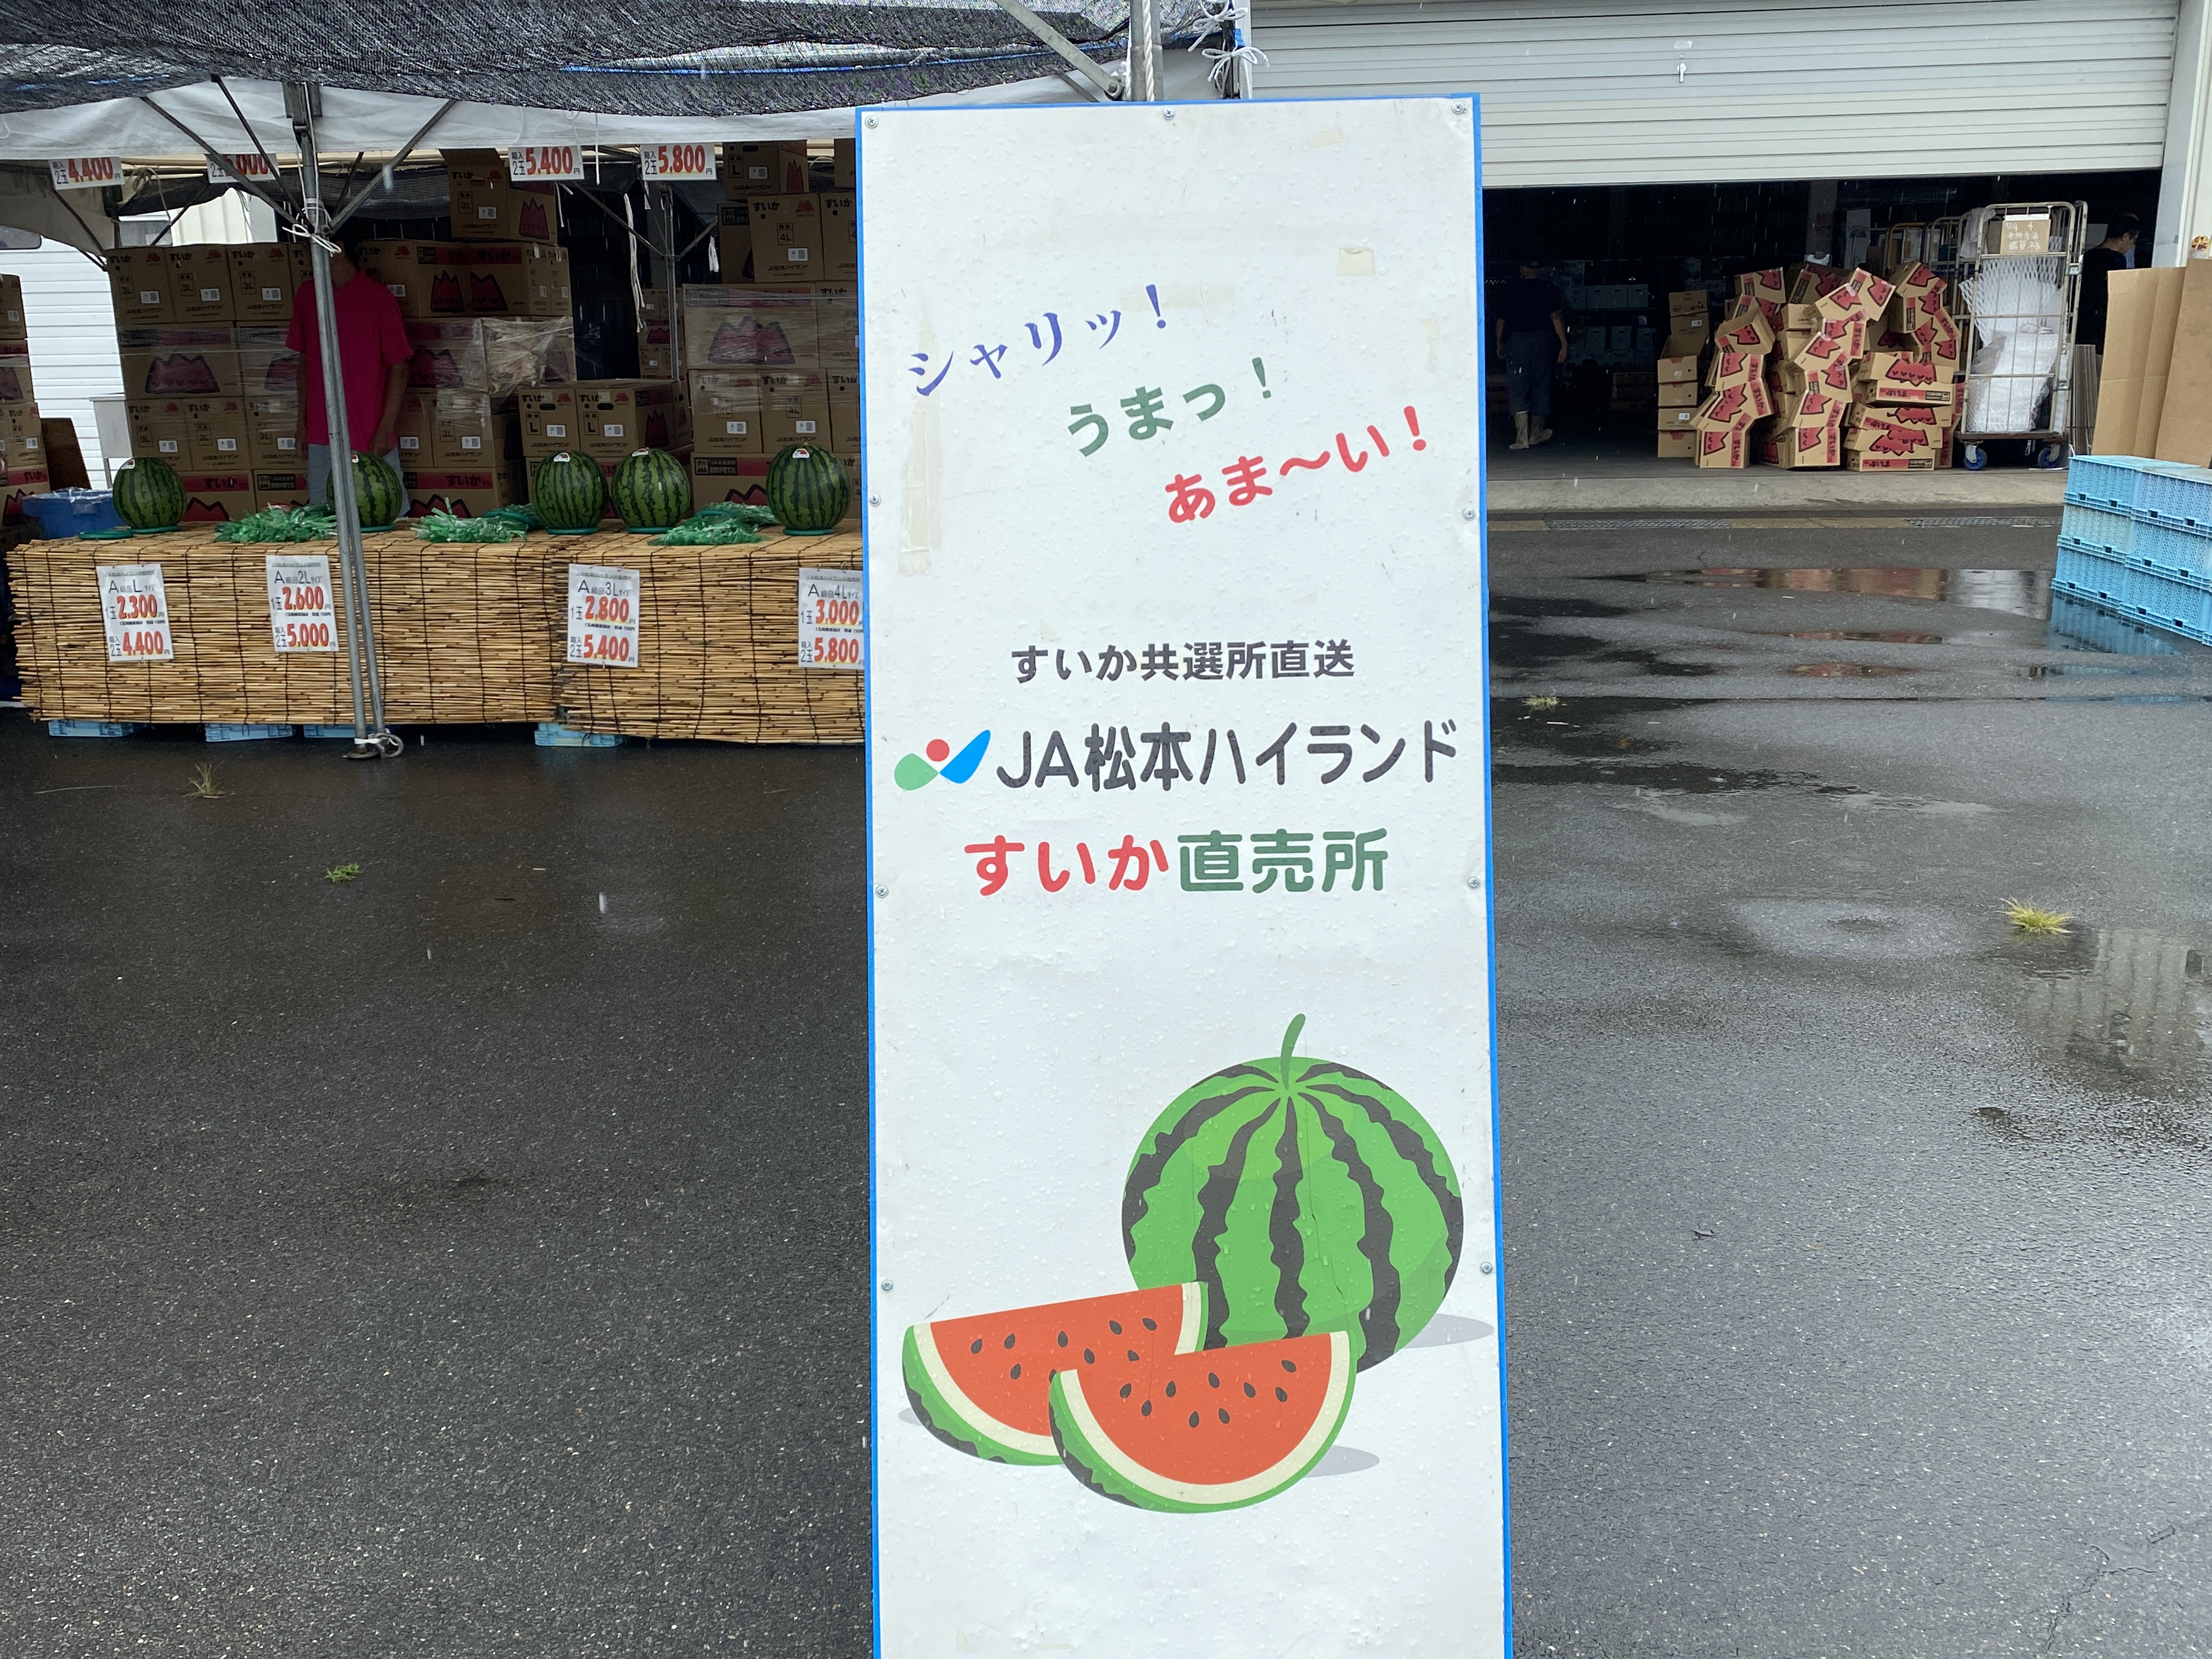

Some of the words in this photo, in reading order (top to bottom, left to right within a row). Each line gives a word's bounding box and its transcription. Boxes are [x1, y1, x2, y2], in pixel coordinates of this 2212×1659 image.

[644, 151, 656, 159] 箱入
[512, 161, 526, 175] 2玉
[645, 161, 658, 175] 2玉
[732, 165, 741, 176] L
[451, 171, 473, 179] すいか
[753, 202, 780, 211] すいか
[826, 199, 852, 208] すいか
[109, 255, 132, 264] すいか
[169, 252, 191, 262] すいか
[232, 250, 255, 259] すいか
[121, 287, 132, 295] 3L
[521, 394, 544, 403] すいか
[128, 404, 150, 413] すいか
[529, 422, 538, 432] L
[588, 422, 596, 432] L
[140, 435, 151, 443] 3L
[203, 477, 238, 488] すいか
[445, 475, 481, 487] すいか
[1011, 639, 1355, 684] すいか共選所直送
[996, 718, 1457, 792] JA松本ハイランド
[964, 827, 1389, 896] すいか直売所
